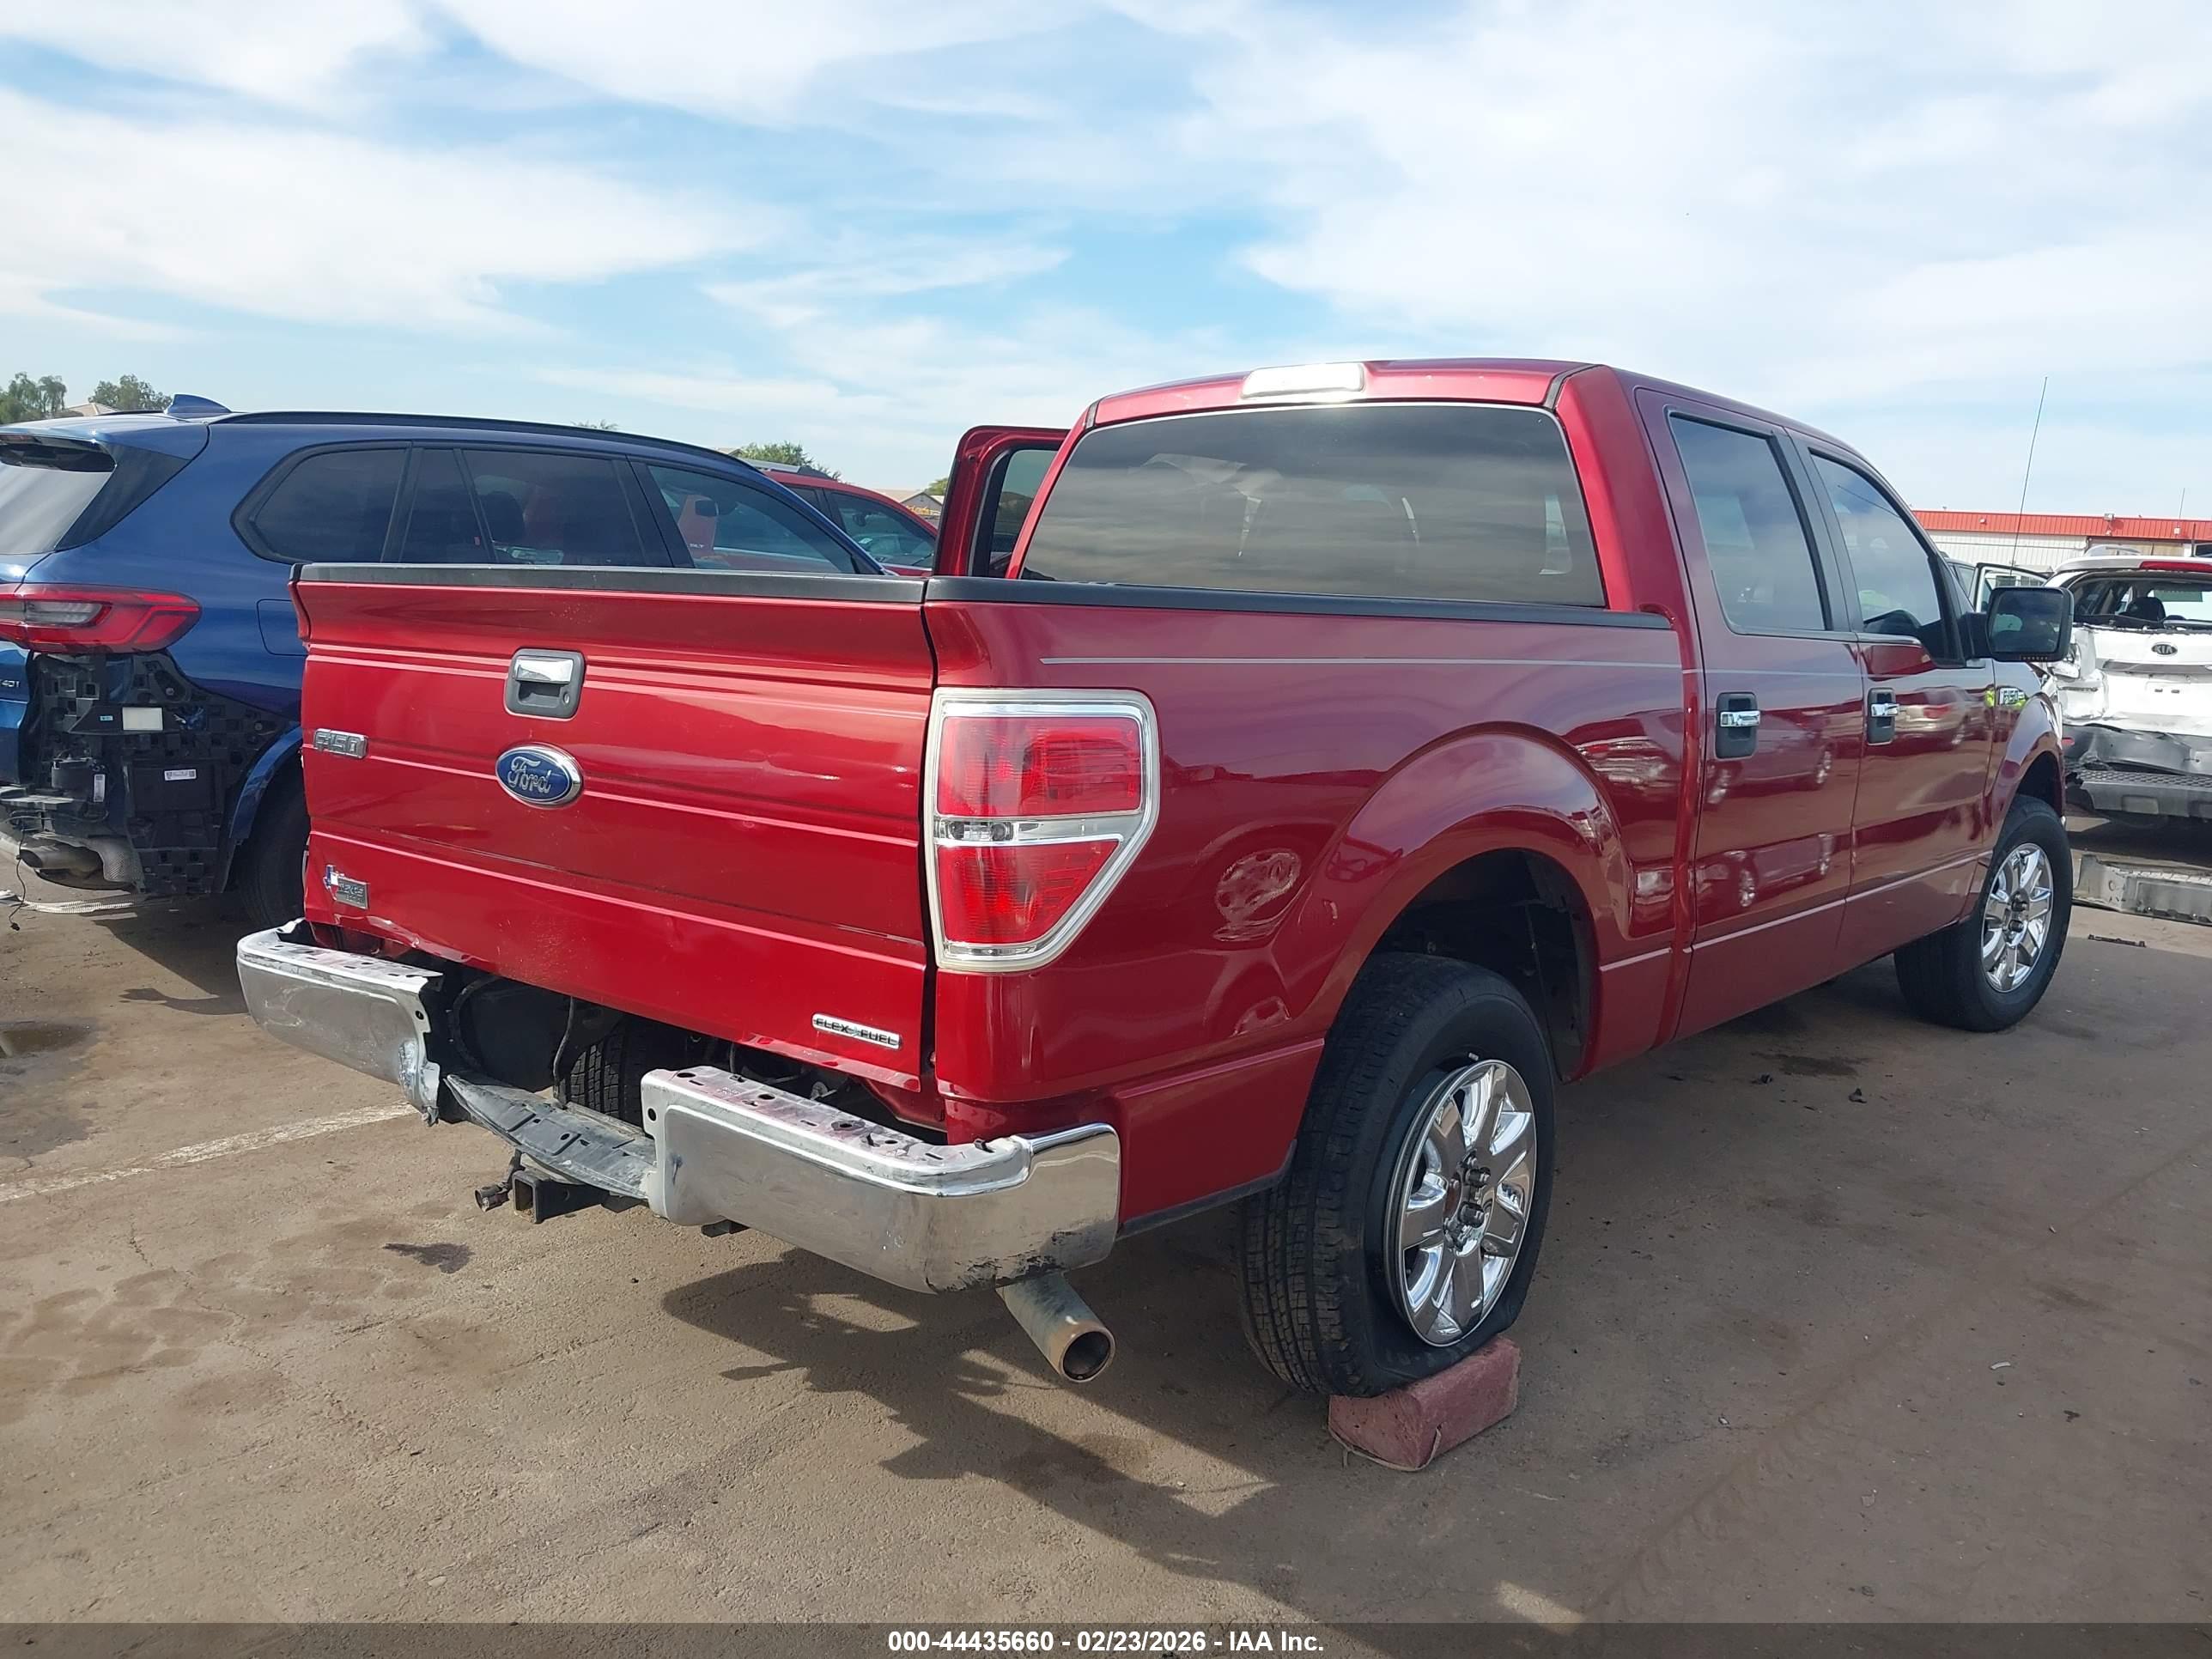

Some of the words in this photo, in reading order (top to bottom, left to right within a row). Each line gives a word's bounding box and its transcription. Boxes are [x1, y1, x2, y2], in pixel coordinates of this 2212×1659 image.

[2155, 645, 2173, 654] KIA
[507, 756, 552, 794] Ford
[815, 1017, 848, 1033] FLEX
[860, 1029, 898, 1046] FUEL
